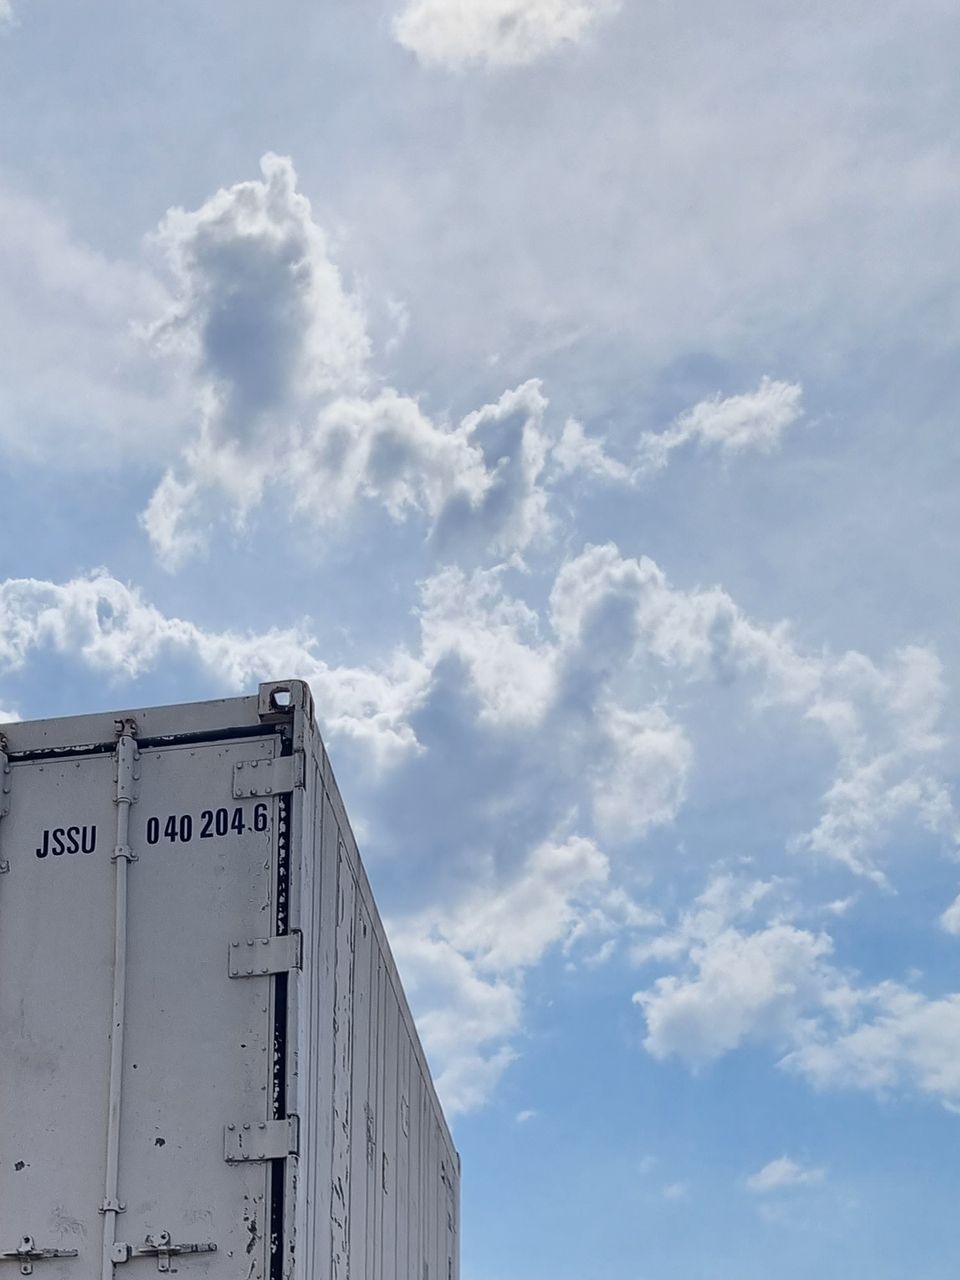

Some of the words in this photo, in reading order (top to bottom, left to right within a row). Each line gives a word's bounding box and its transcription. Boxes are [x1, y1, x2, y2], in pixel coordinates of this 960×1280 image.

[36, 825, 97, 859] JSSU
[146, 815, 193, 845] 040
[200, 803, 268, 839] 204.6
